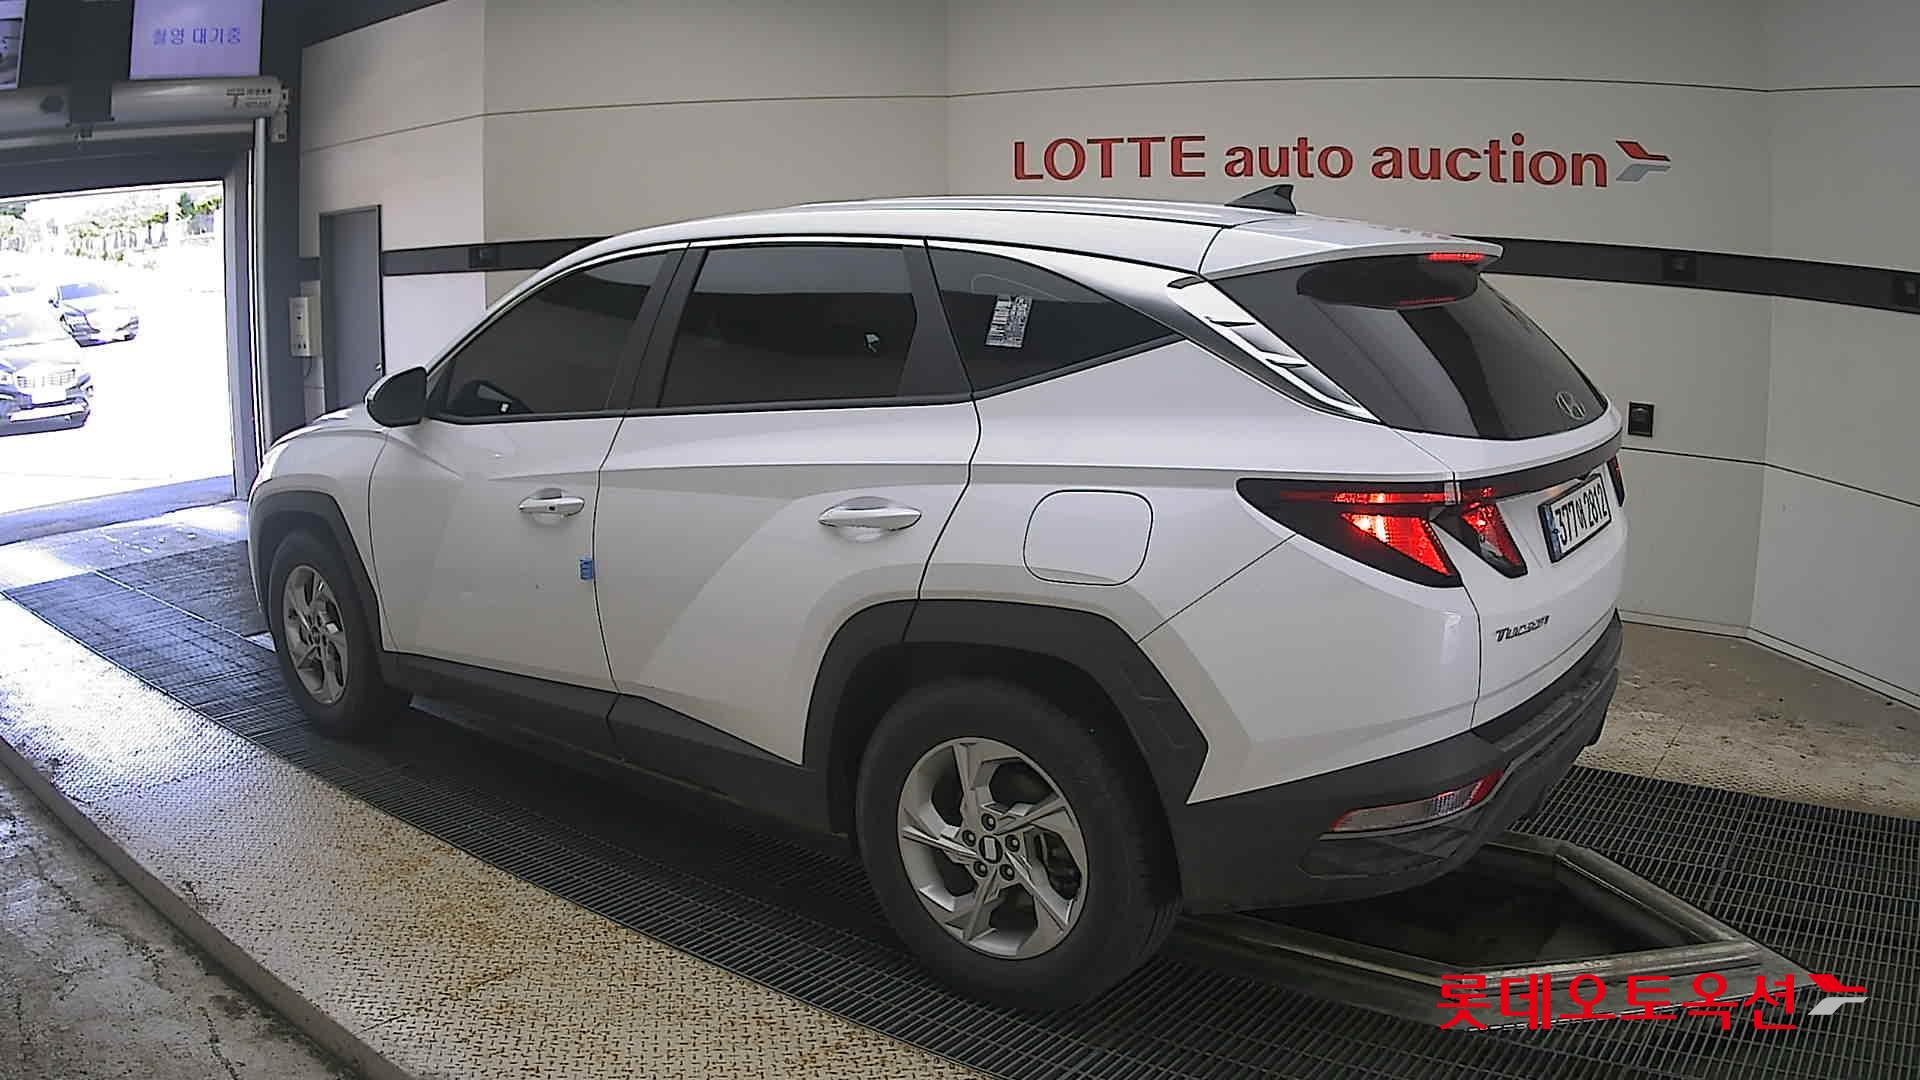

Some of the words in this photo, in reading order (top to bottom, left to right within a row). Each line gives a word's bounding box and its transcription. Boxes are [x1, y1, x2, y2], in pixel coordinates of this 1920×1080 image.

[192, 27, 241, 44] 대기중
[1013, 135, 1207, 181] LOTTE
[1223, 136, 1354, 179] auto
[1370, 132, 1608, 187] auction
